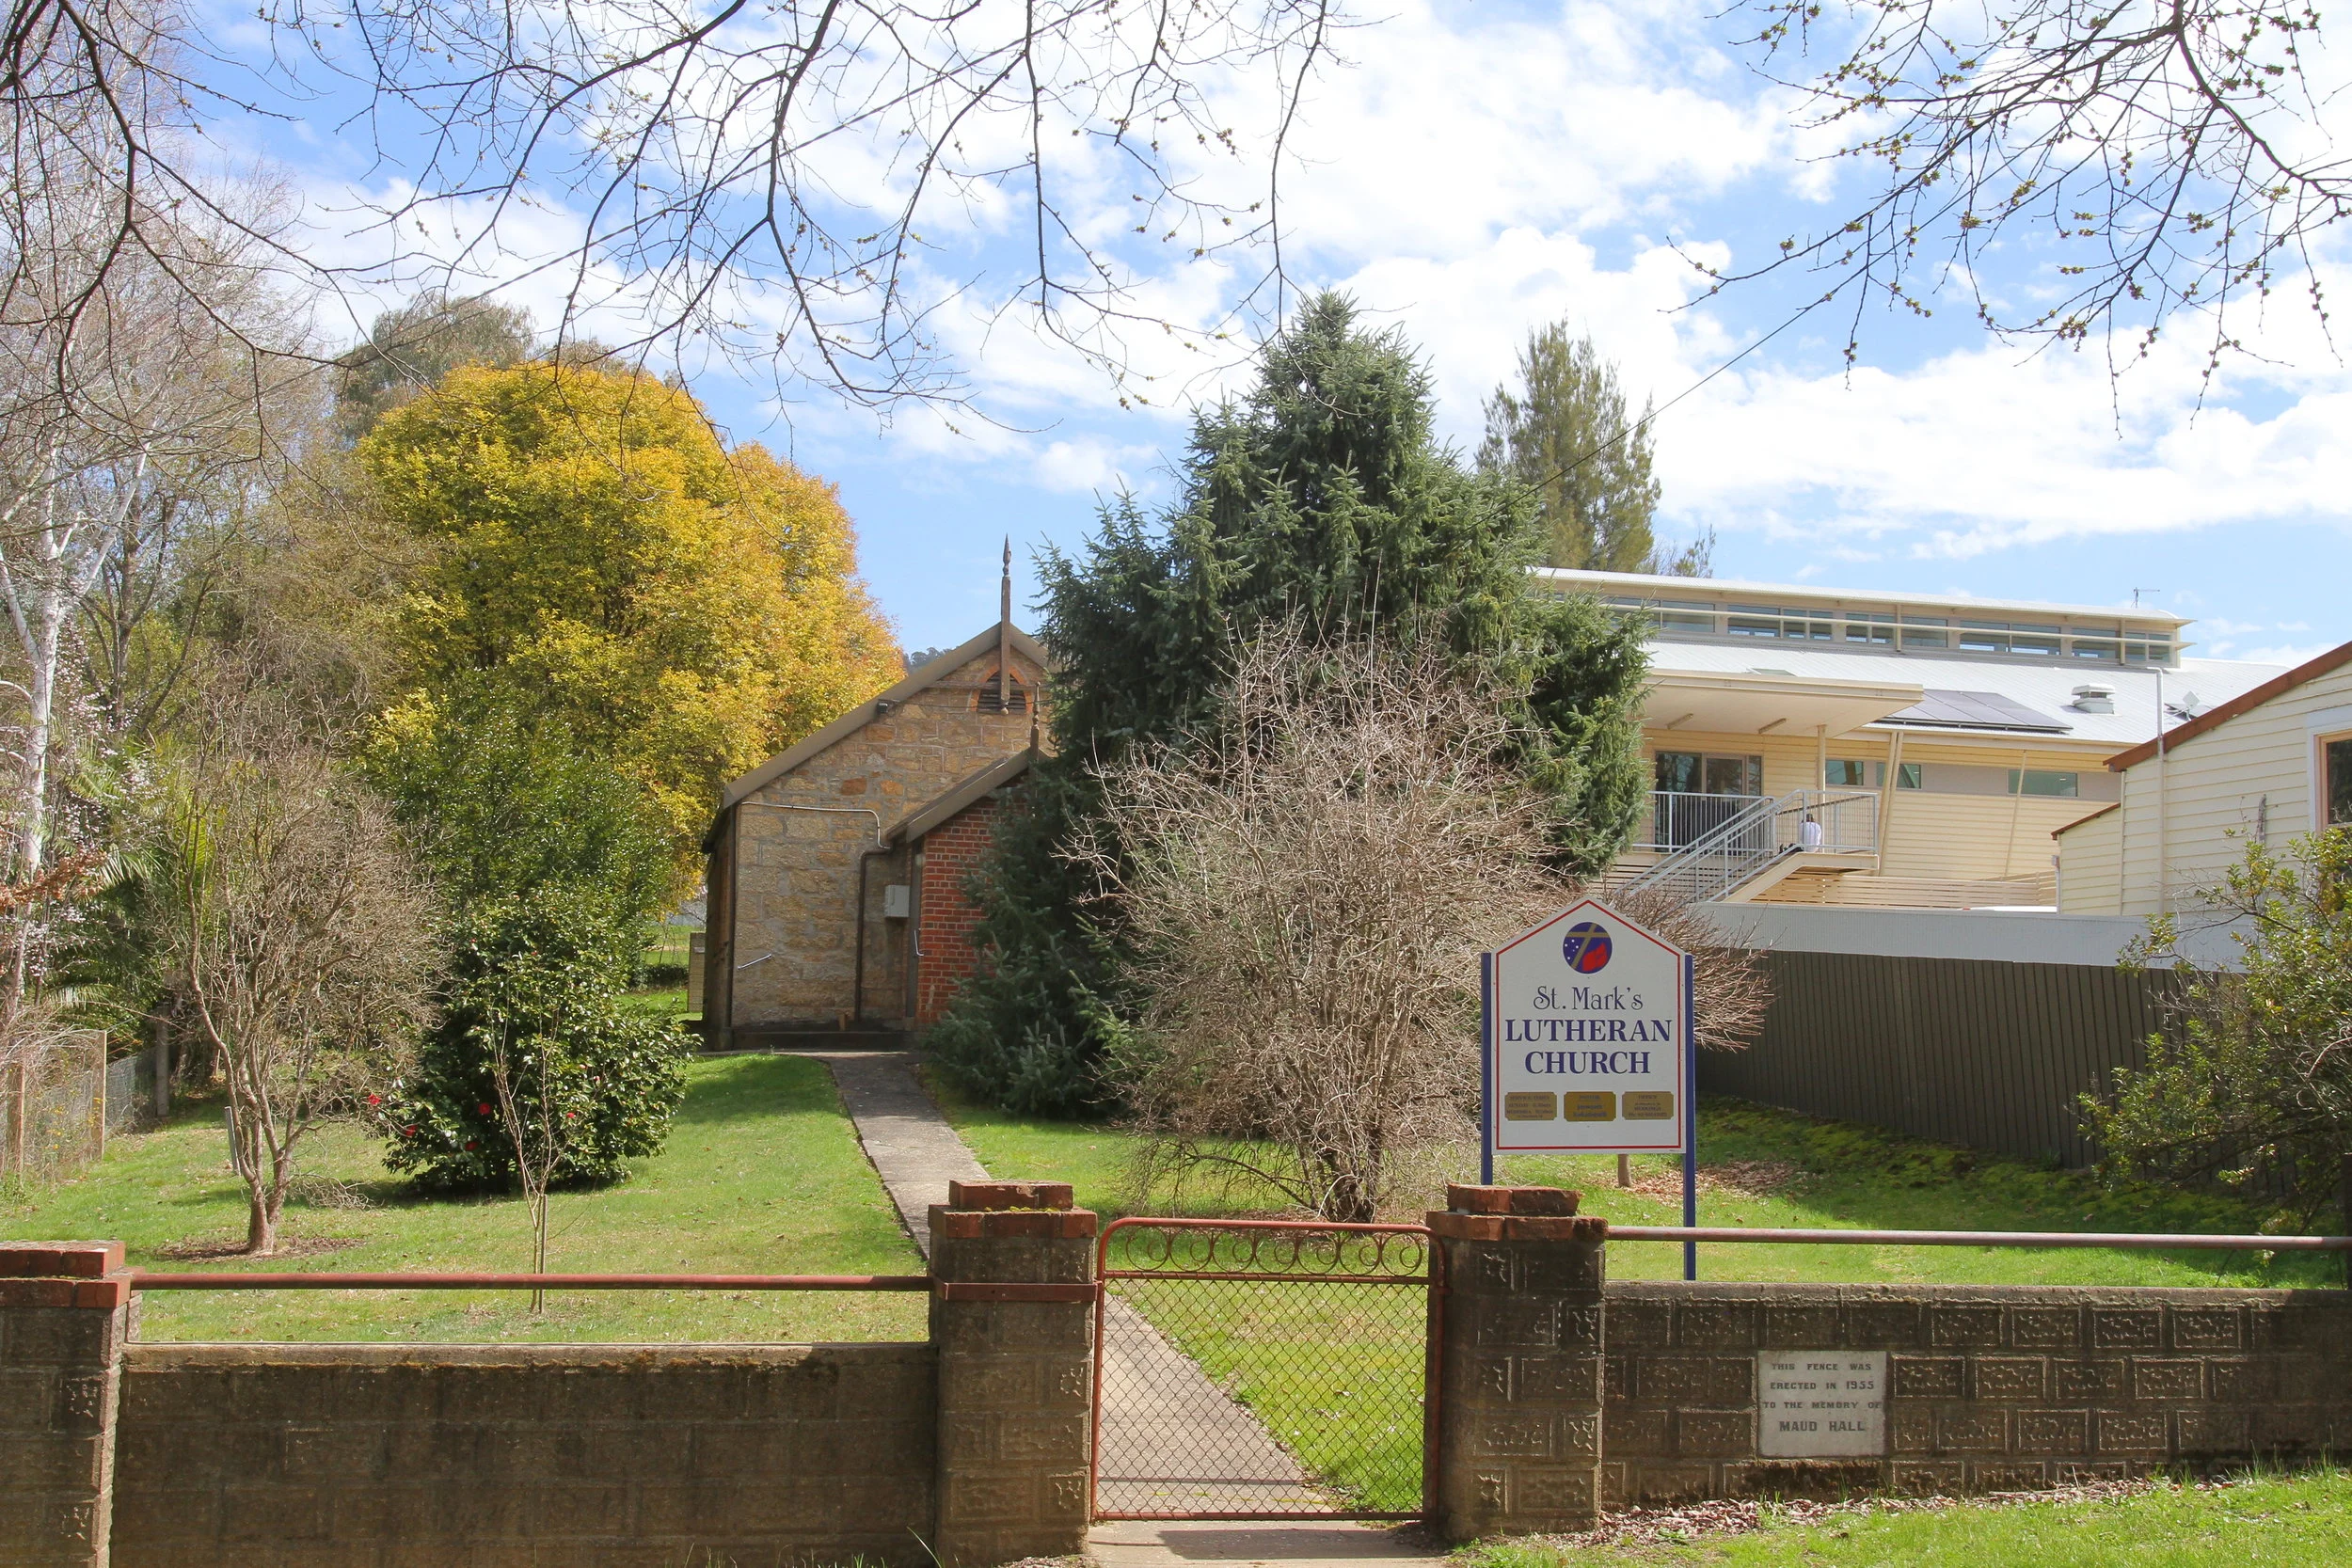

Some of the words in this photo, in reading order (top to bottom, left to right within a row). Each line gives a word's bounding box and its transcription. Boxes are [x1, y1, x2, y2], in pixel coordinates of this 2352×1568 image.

[1533, 985, 1566, 1010] St.
[1571, 986, 1644, 1010] Mark's
[1505, 1019, 1673, 1042] LUTHERAN
[1524, 1051, 1651, 1074] CHURCH
[1770, 1382, 1817, 1390] ERECTED
[1779, 1420, 1818, 1432] MAUD
[1828, 1420, 1866, 1432] HALL
